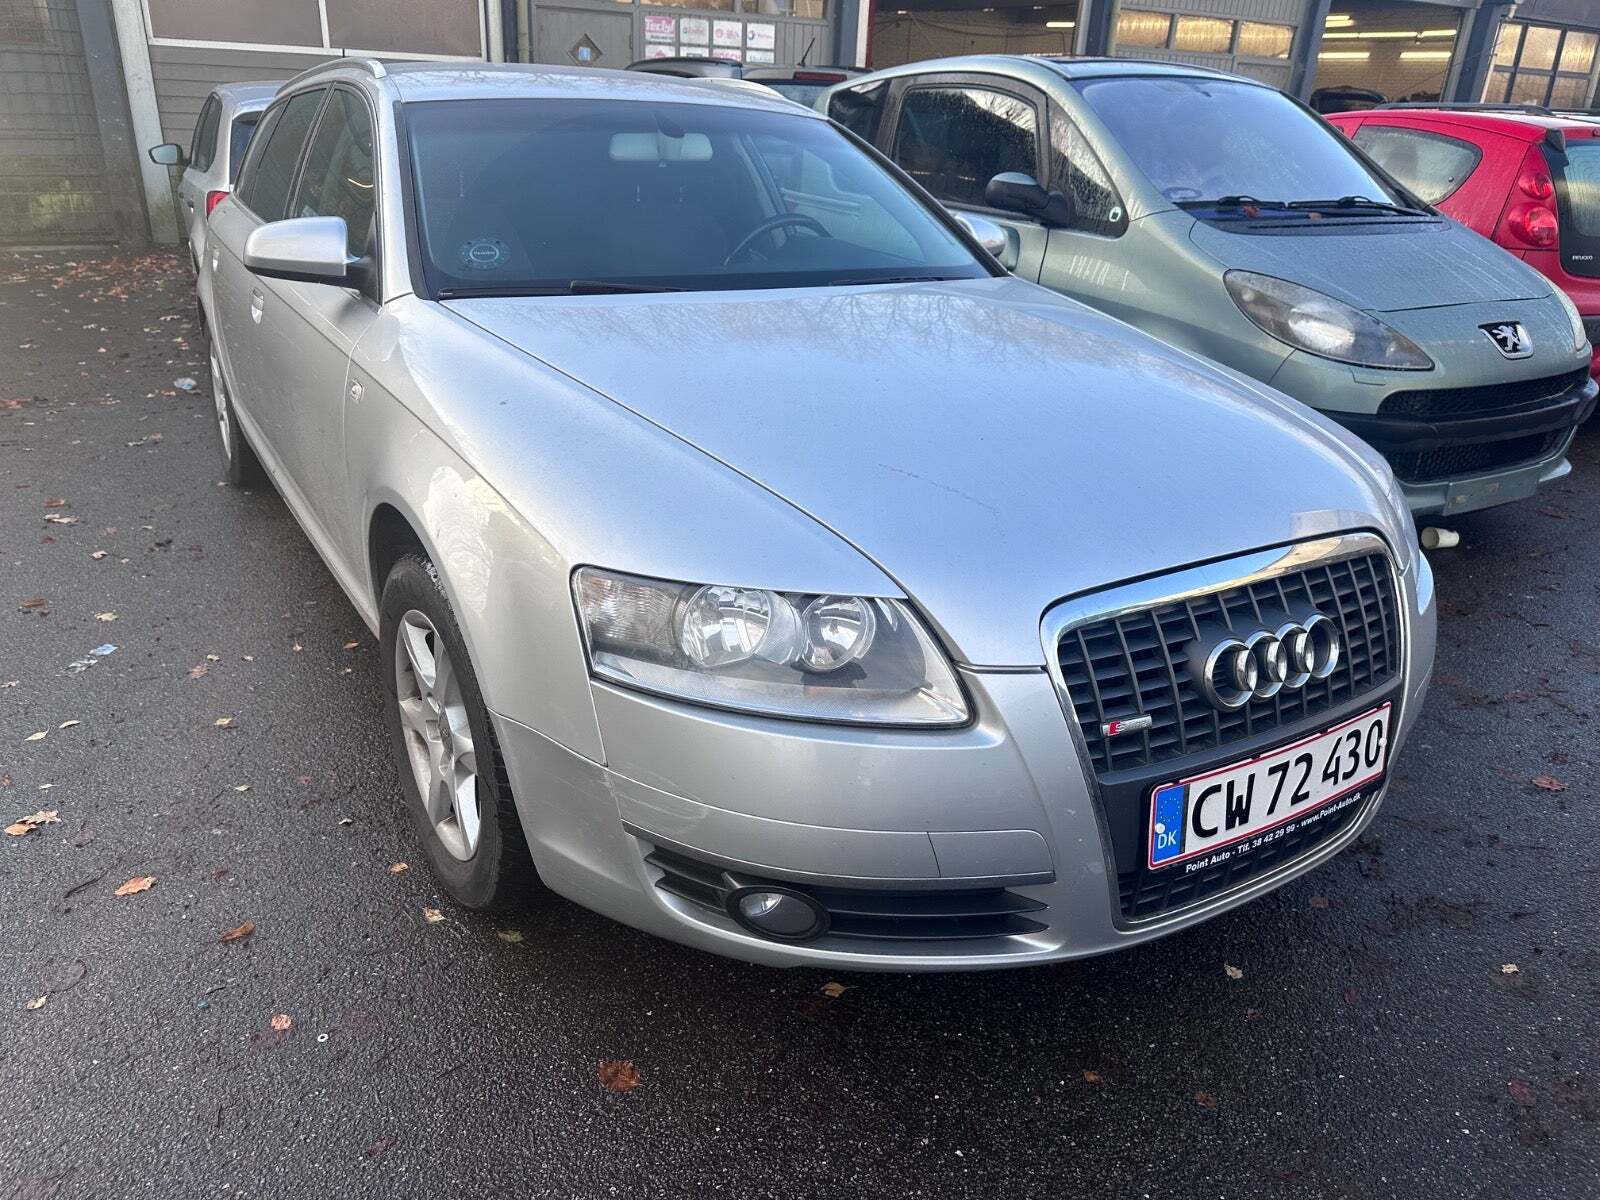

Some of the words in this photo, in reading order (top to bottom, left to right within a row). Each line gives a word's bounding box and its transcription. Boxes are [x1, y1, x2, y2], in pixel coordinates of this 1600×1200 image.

[1191, 773, 1255, 838] CW
[1266, 752, 1313, 816] 72
[1321, 719, 1383, 786] 430
[1157, 831, 1176, 850] DK
[1185, 859, 1209, 874] Point
[1211, 850, 1231, 866] Auto
[1252, 839, 1262, 849] 38
[1263, 833, 1274, 845] 42
[1274, 829, 1285, 840] 29
[1285, 824, 1296, 835] 99
[1301, 793, 1361, 827] www.Point-Auto.dk
